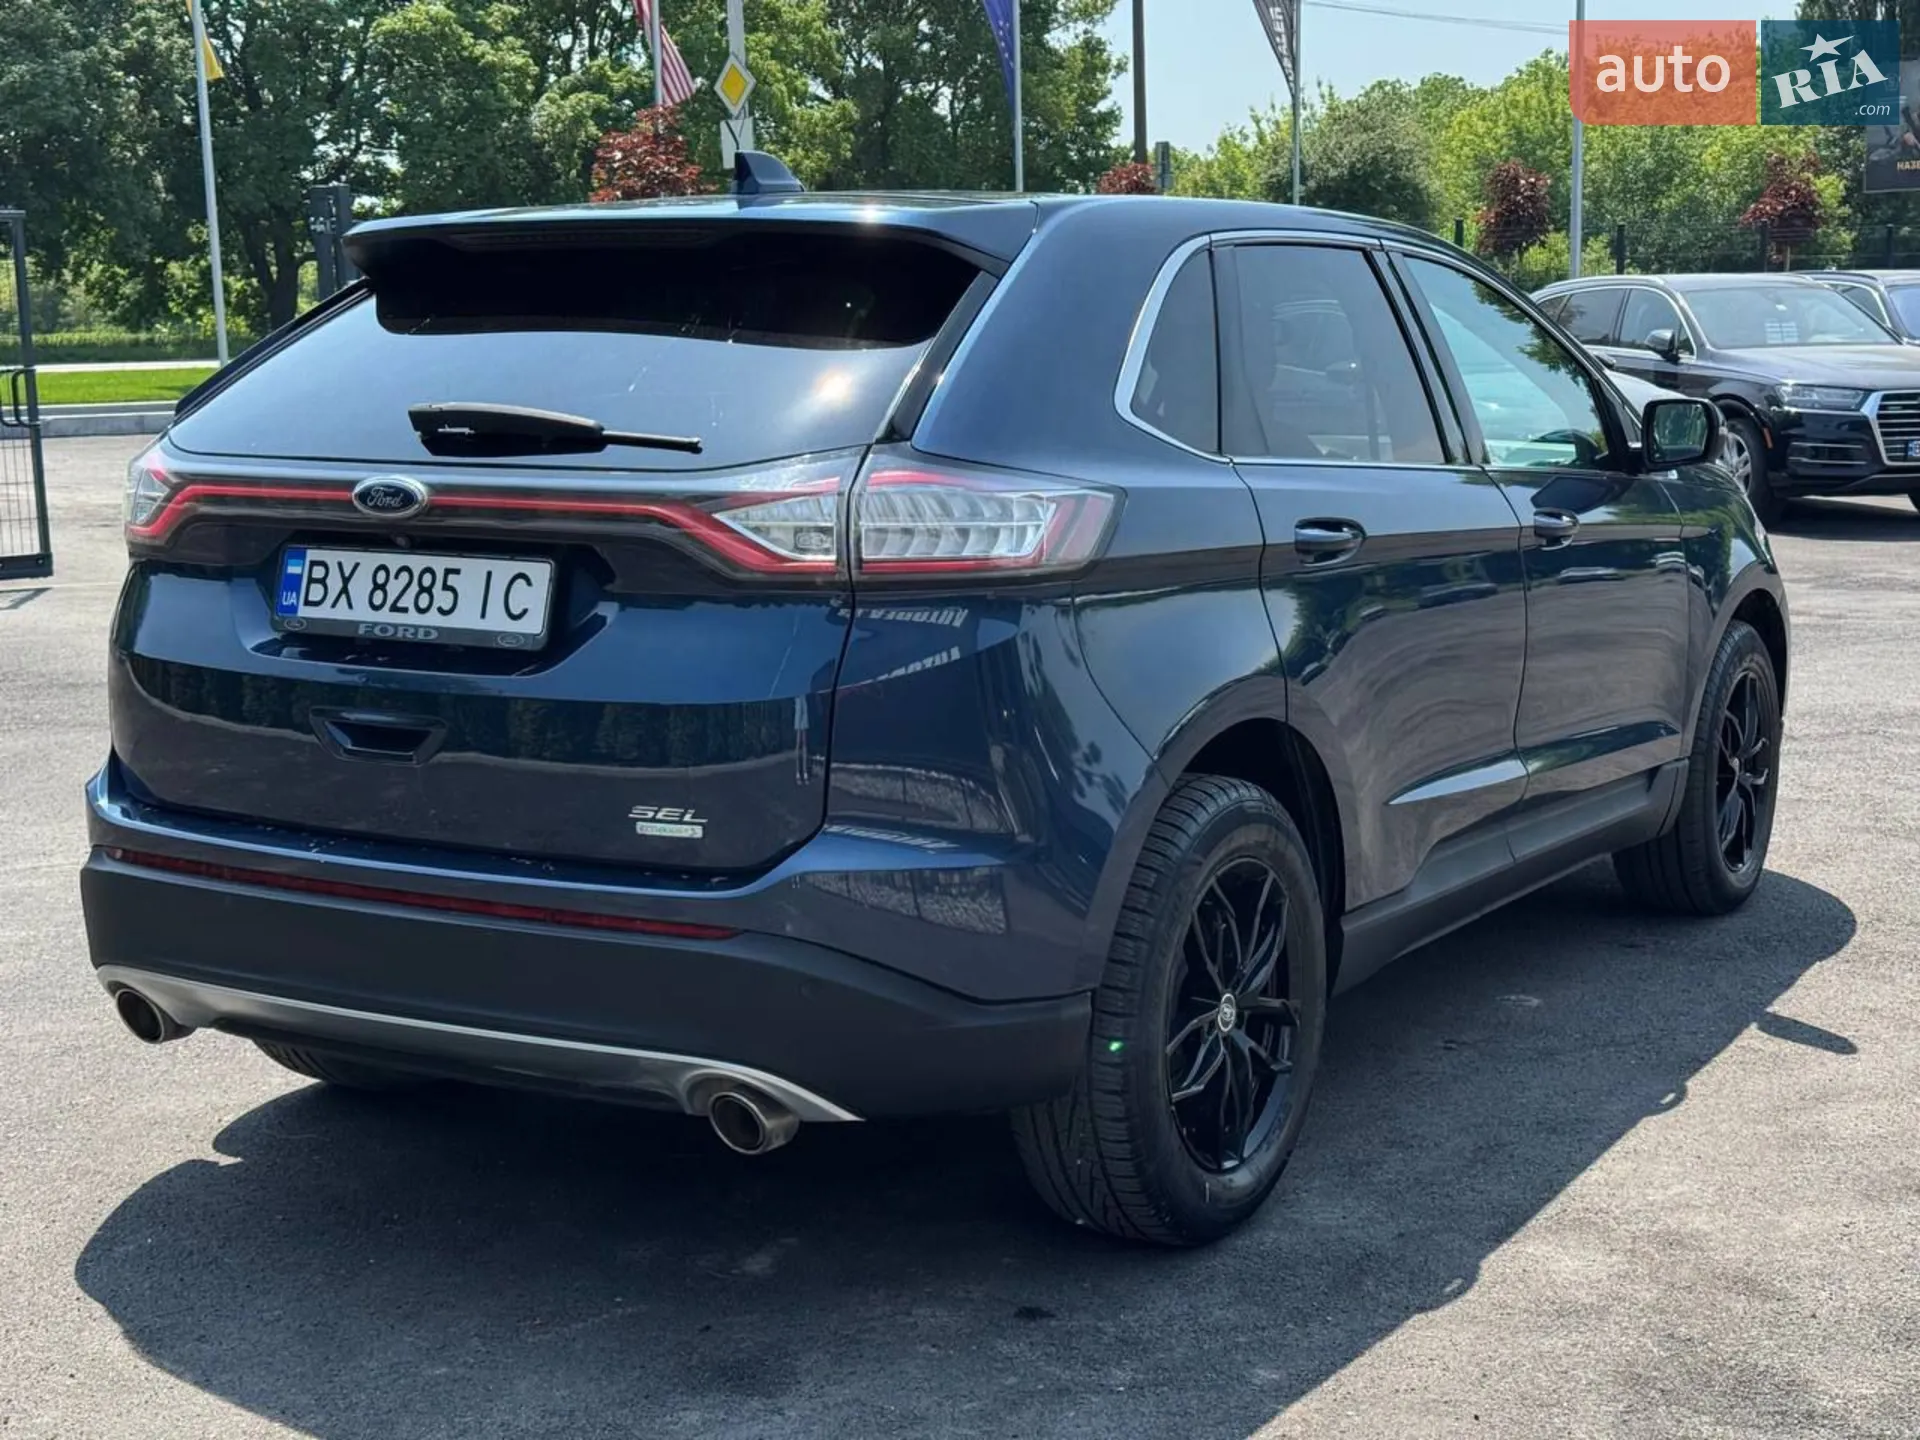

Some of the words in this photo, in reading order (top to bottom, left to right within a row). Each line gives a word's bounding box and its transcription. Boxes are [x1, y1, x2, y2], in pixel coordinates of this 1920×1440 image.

[366, 486, 405, 508] Ford
[281, 590, 298, 606] UA
[302, 559, 361, 610] BX
[367, 563, 462, 617] 8285
[479, 569, 534, 621] IC
[356, 623, 439, 641] FORD
[627, 805, 709, 823] SEL
